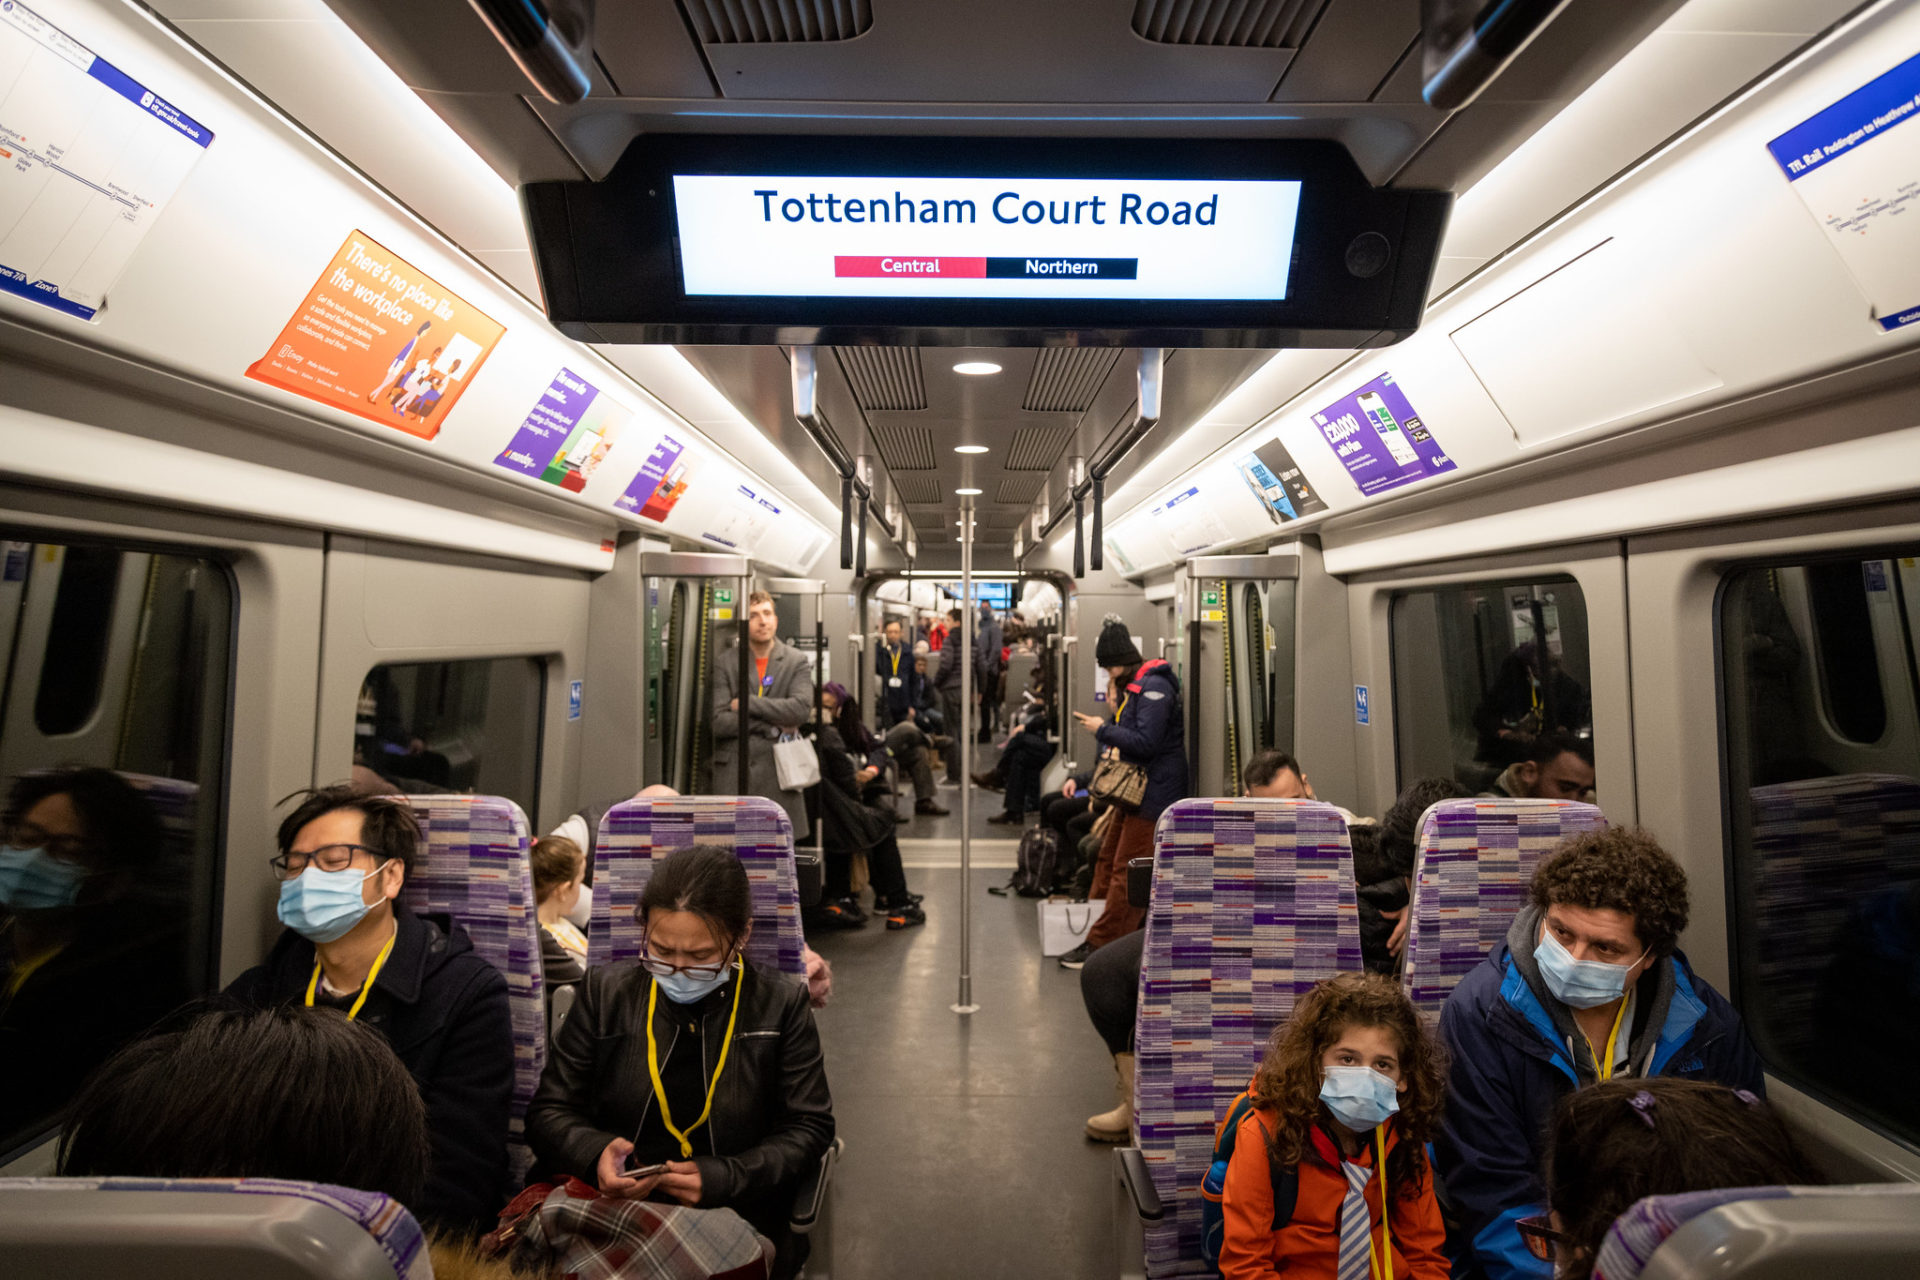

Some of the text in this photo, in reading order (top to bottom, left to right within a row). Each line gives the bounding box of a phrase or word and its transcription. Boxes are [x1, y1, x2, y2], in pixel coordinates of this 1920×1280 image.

[1802, 148, 1824, 165] Rail
[1823, 129, 1865, 155] Paddington
[1863, 123, 1875, 133] to
[1872, 101, 1914, 128] Heathrow
[754, 190, 1218, 225] Tottenham Court Road
[346, 241, 454, 320] There's no place like
[881, 258, 940, 272] Central
[1026, 260, 1097, 274] Northern
[34, 280, 52, 293] Zone
[52, 286, 58, 294] 9
[329, 267, 413, 324] the workplace
[286, 349, 304, 363] Envoy
[1323, 412, 1360, 444] £20,000
